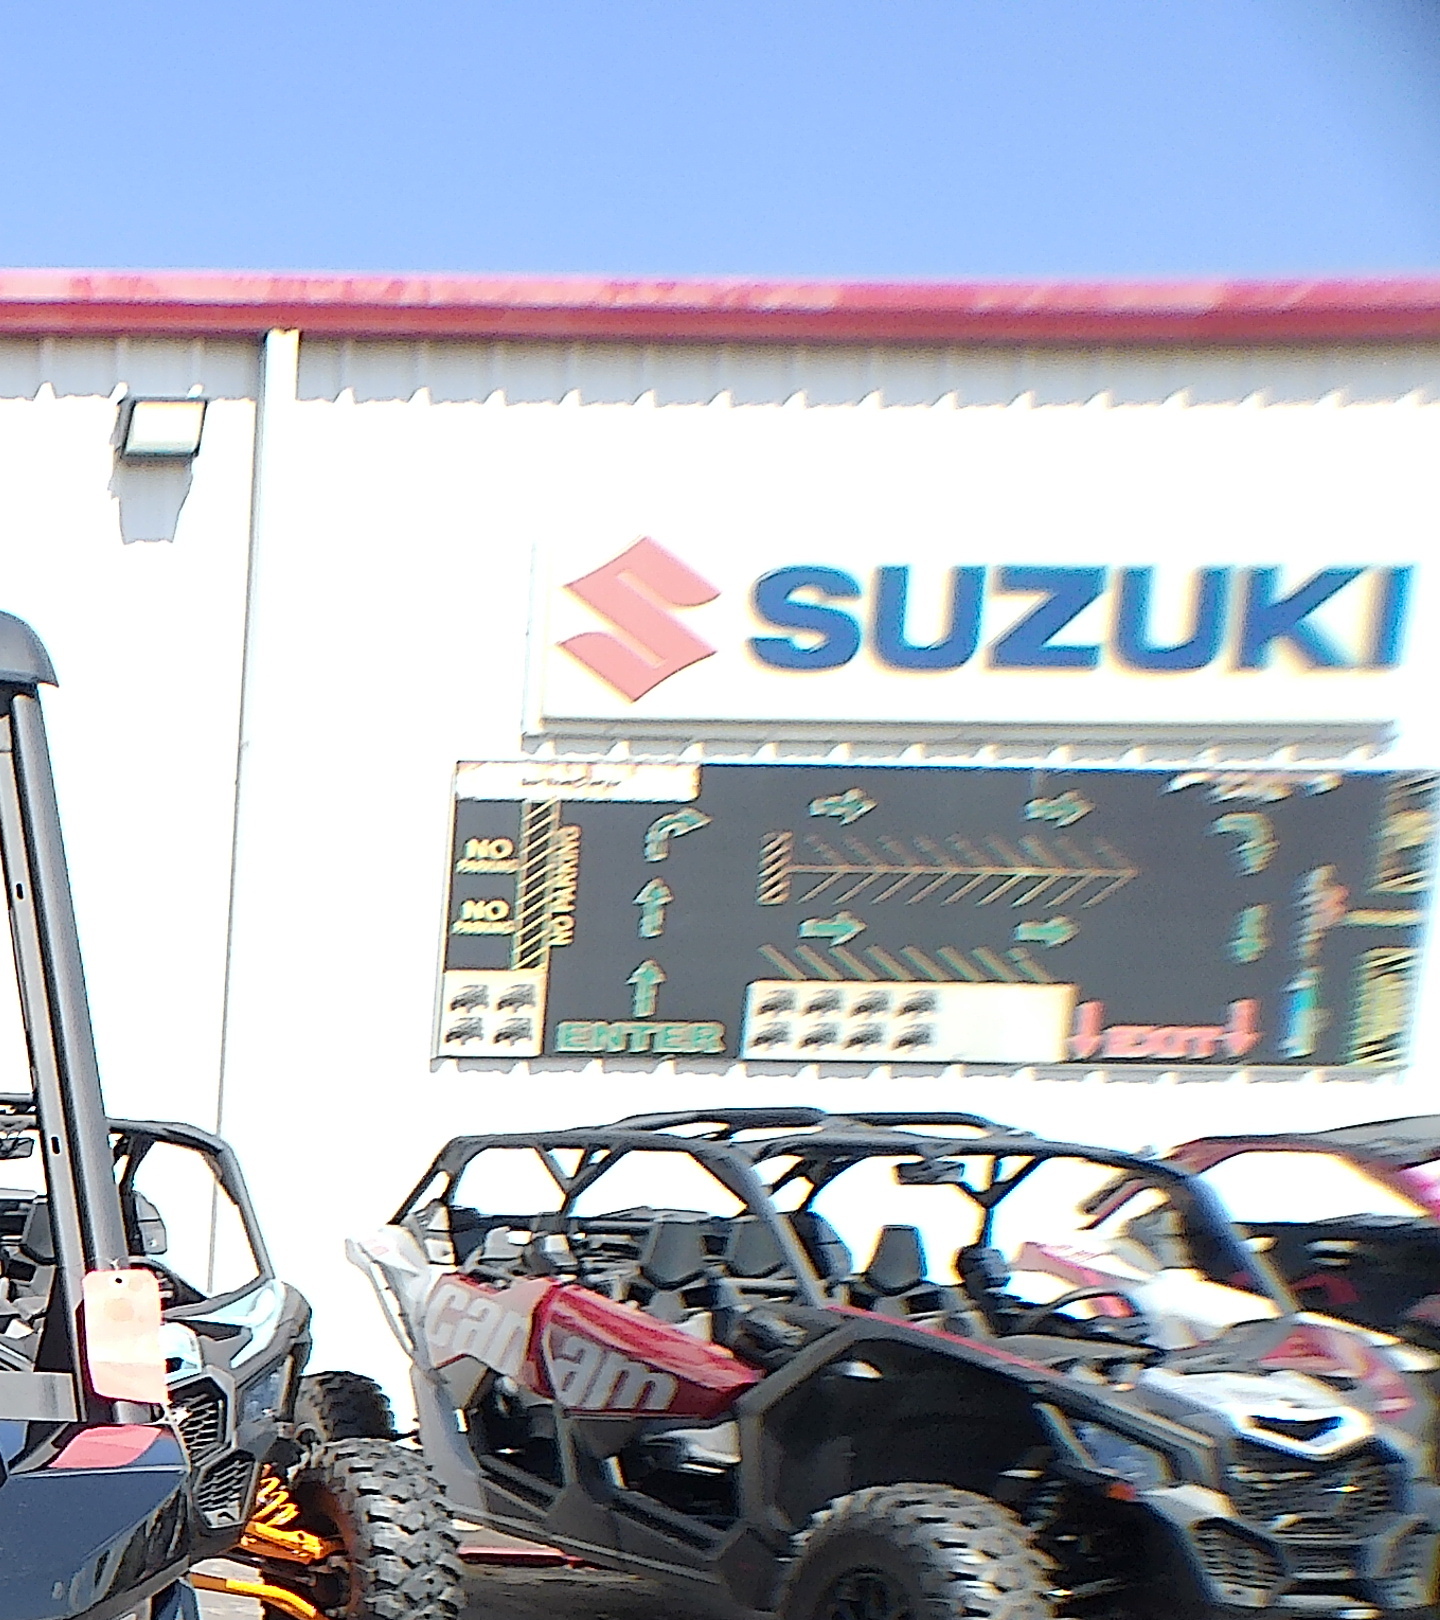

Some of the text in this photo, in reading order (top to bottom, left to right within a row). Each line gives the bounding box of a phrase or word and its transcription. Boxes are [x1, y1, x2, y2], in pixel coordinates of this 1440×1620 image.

[749, 563, 1413, 671] SUZUKI
[465, 838, 513, 859] NO
[461, 899, 509, 920] NO
[556, 1021, 726, 1053] ENTER
